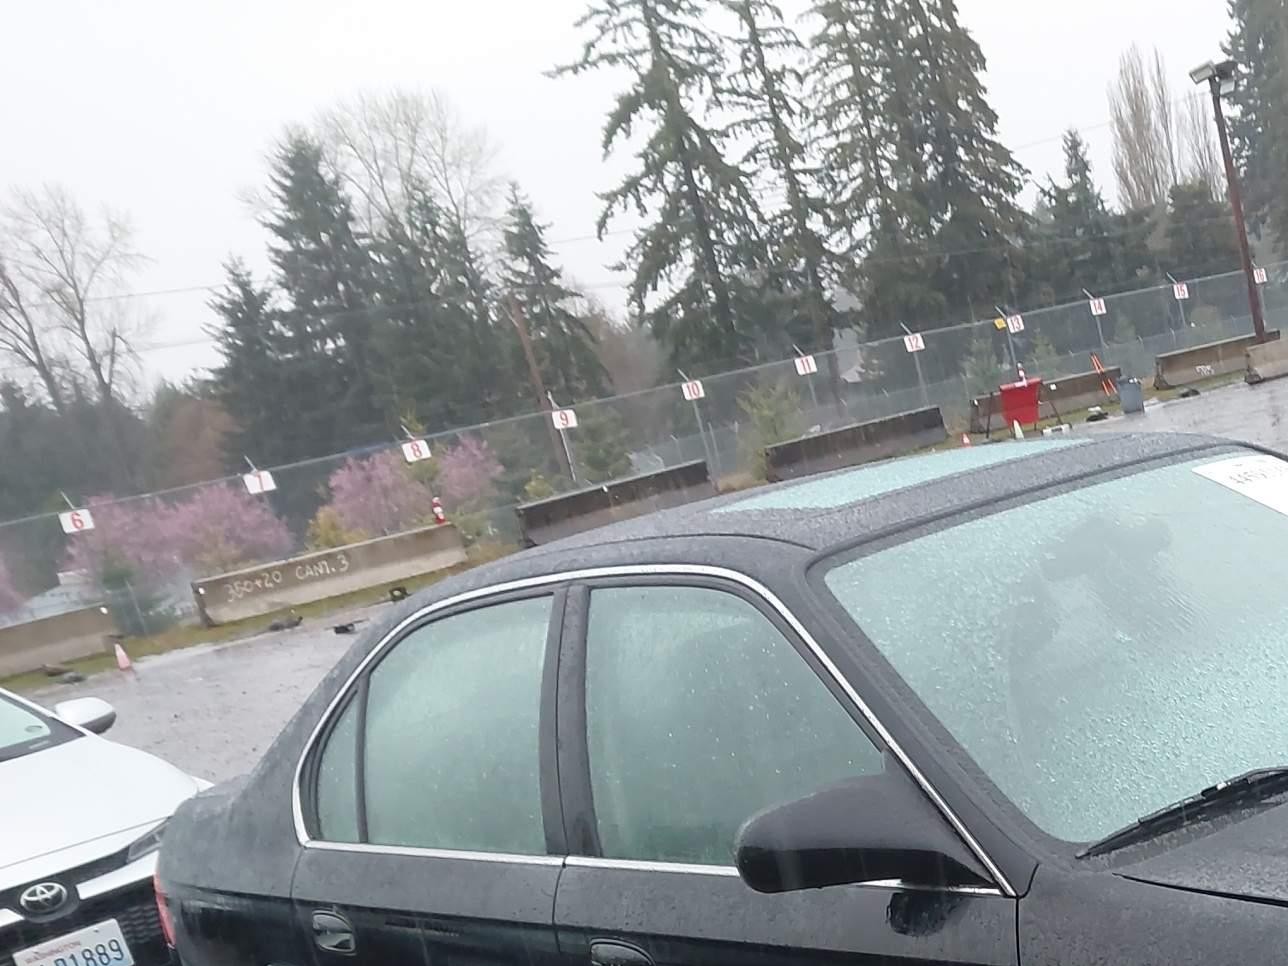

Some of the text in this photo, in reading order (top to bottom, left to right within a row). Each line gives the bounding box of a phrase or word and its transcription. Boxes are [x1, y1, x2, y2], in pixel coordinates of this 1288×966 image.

[1175, 284, 1186, 298] 15
[1093, 299, 1103, 315] 14
[1010, 316, 1022, 332] 13
[908, 335, 920, 350] 12
[800, 358, 812, 374] 11
[686, 383, 701, 398] 10
[559, 411, 569, 427] 9
[410, 443, 423, 458] 8
[70, 511, 85, 530] 6
